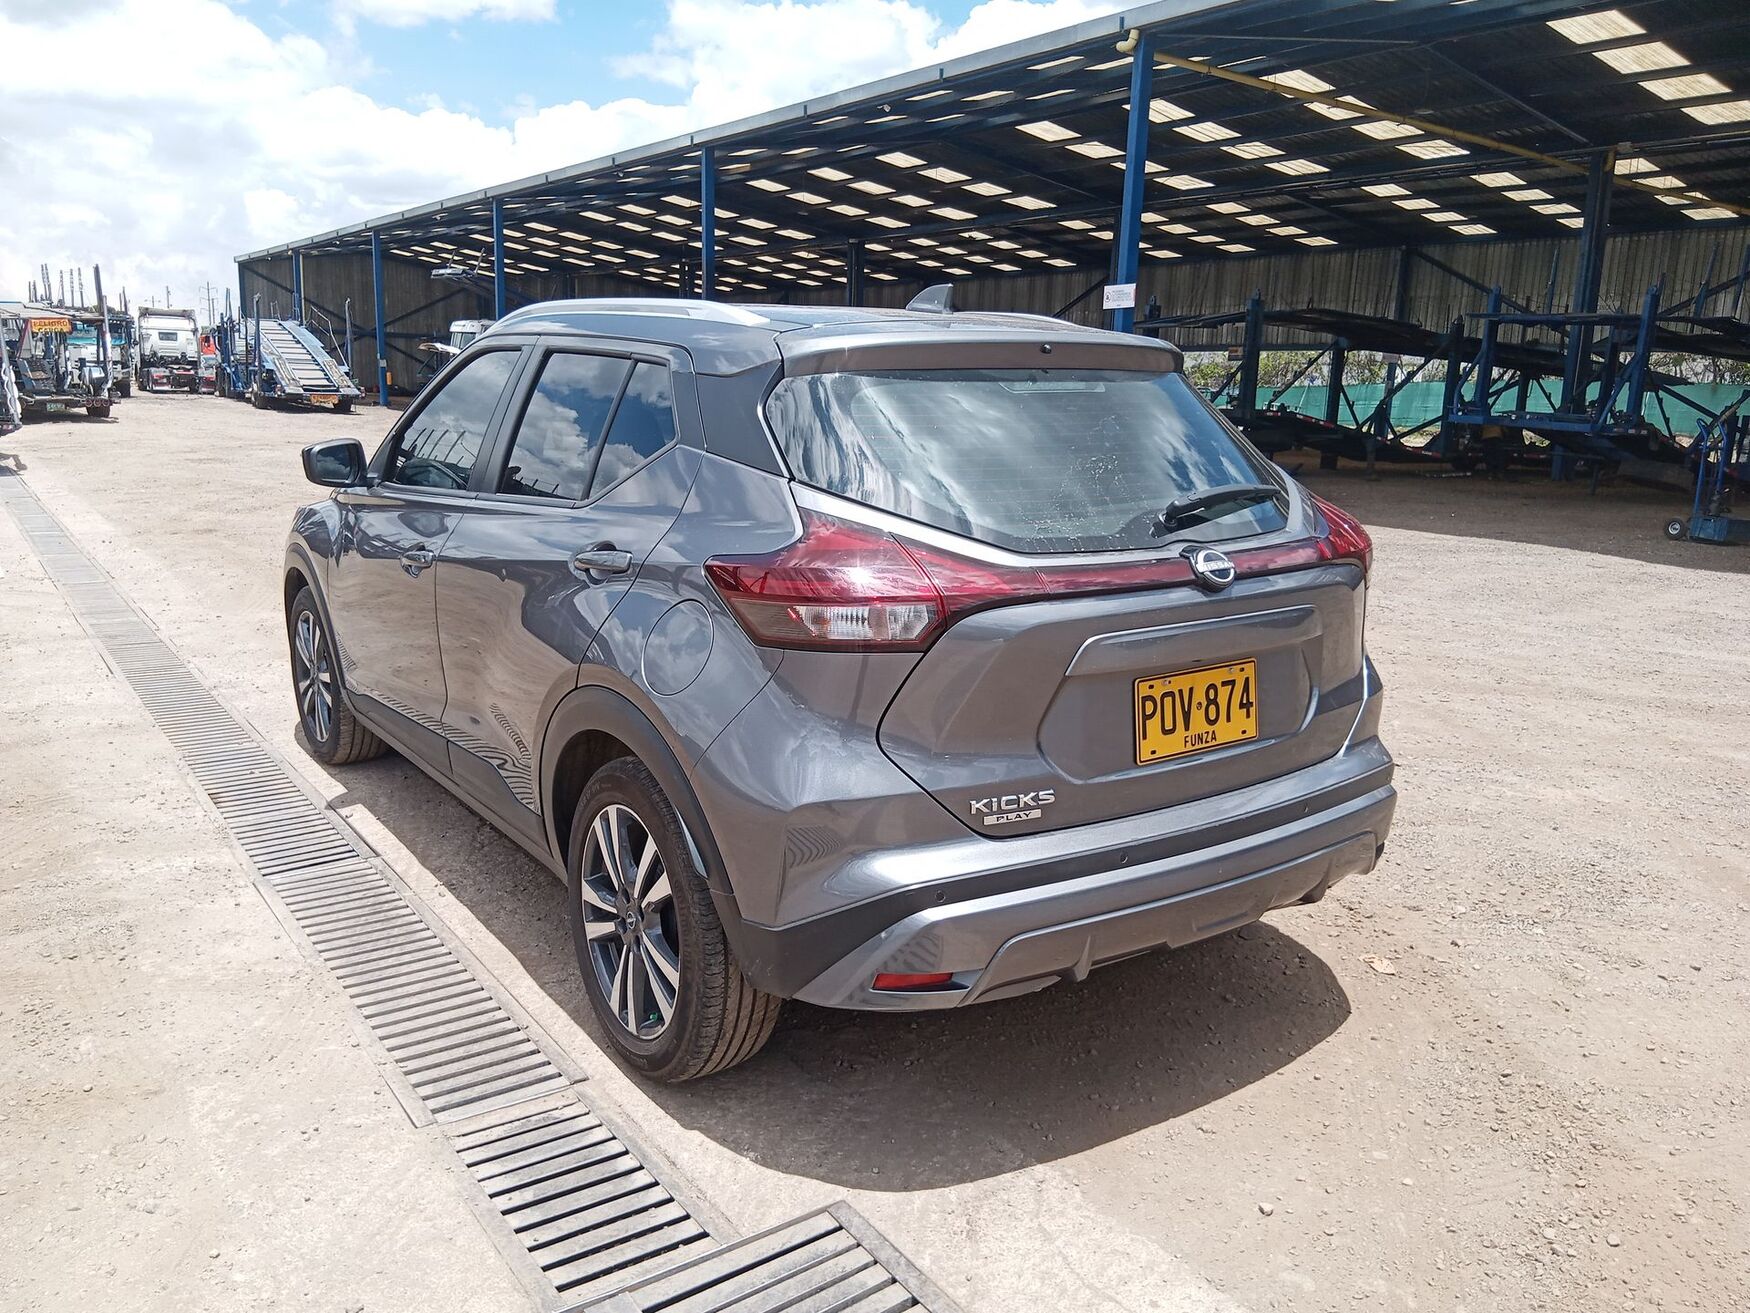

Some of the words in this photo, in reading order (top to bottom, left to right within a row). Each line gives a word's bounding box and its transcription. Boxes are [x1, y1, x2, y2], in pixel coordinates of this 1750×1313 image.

[1204, 676, 1254, 727] 874
[1183, 730, 1217, 748] FUNZA
[969, 788, 1056, 815] KICKS
[996, 811, 1032, 822] PLAY
